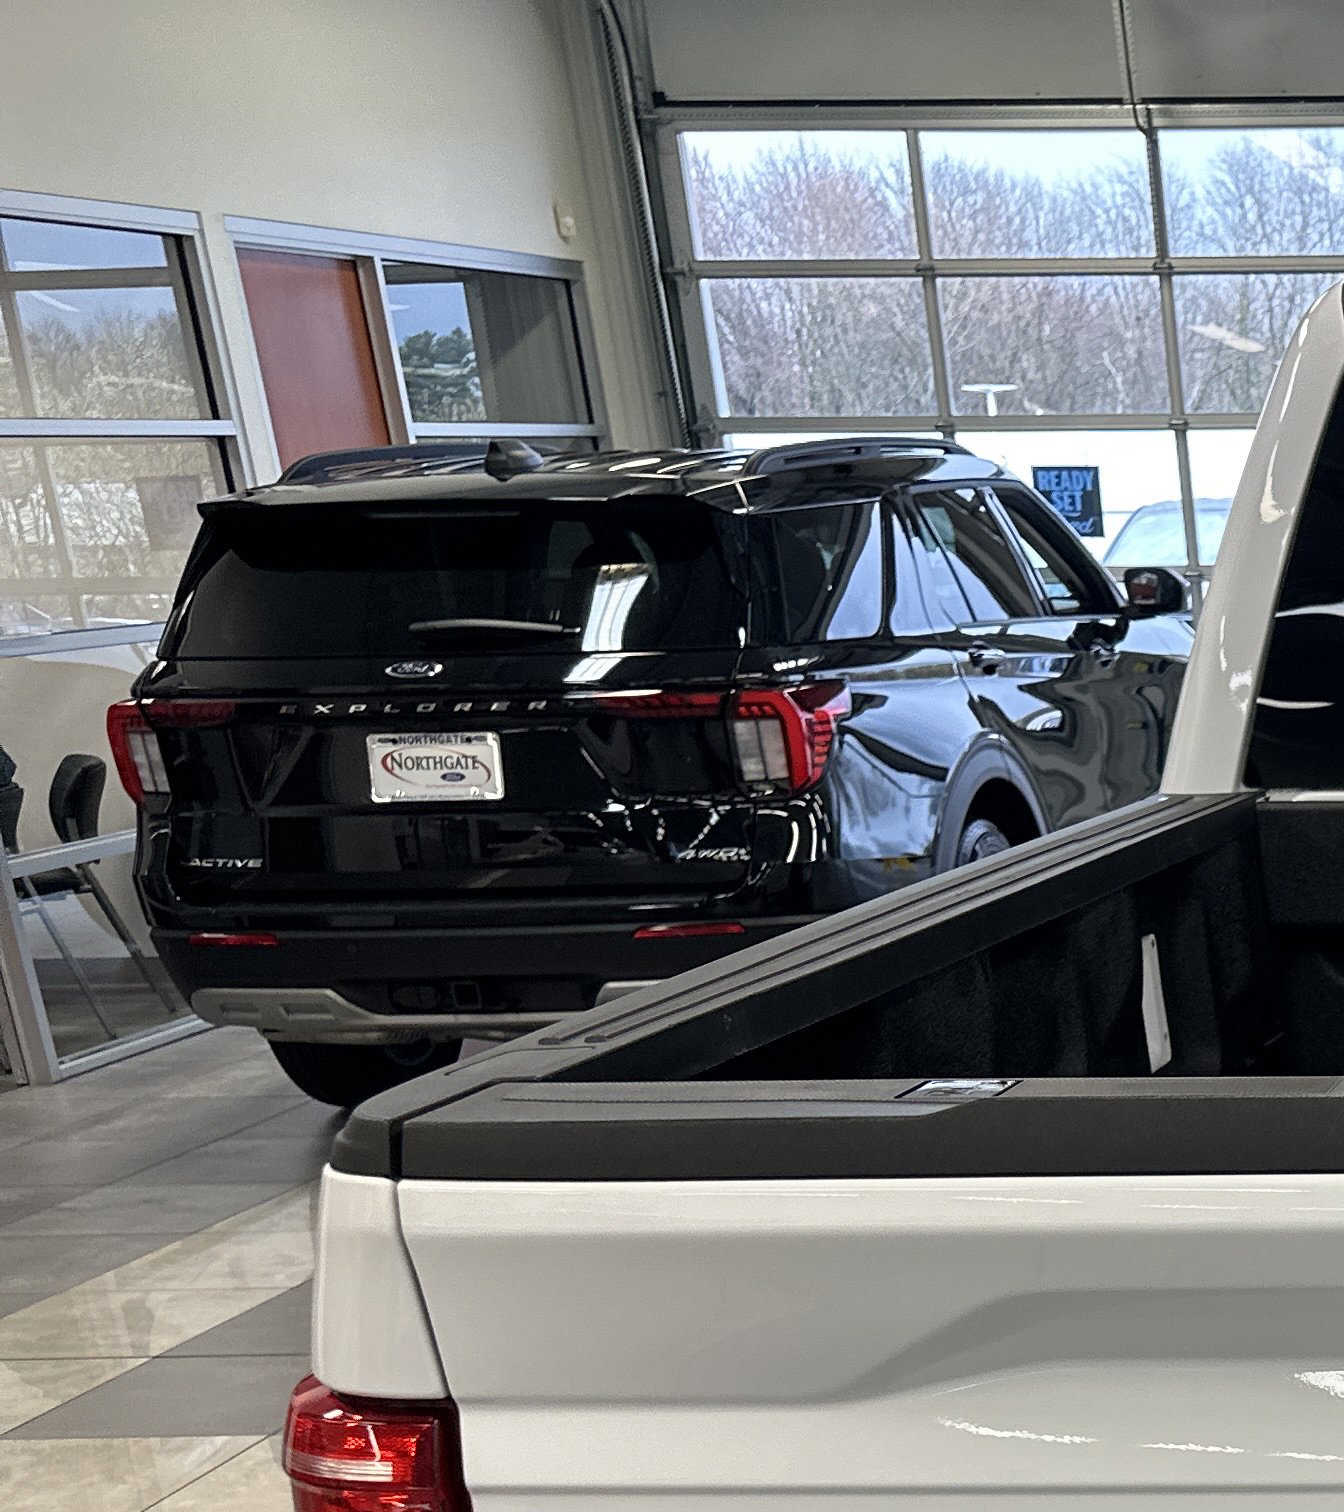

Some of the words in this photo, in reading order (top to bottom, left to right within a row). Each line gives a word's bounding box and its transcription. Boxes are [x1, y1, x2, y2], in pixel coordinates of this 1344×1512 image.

[1037, 470, 1094, 491] READY
[1051, 491, 1083, 512] SET
[279, 700, 548, 715] EXPLORER
[398, 733, 465, 745] NORTHGATE
[390, 753, 480, 771] NORTHGATE
[187, 858, 263, 868] ACTIVE
